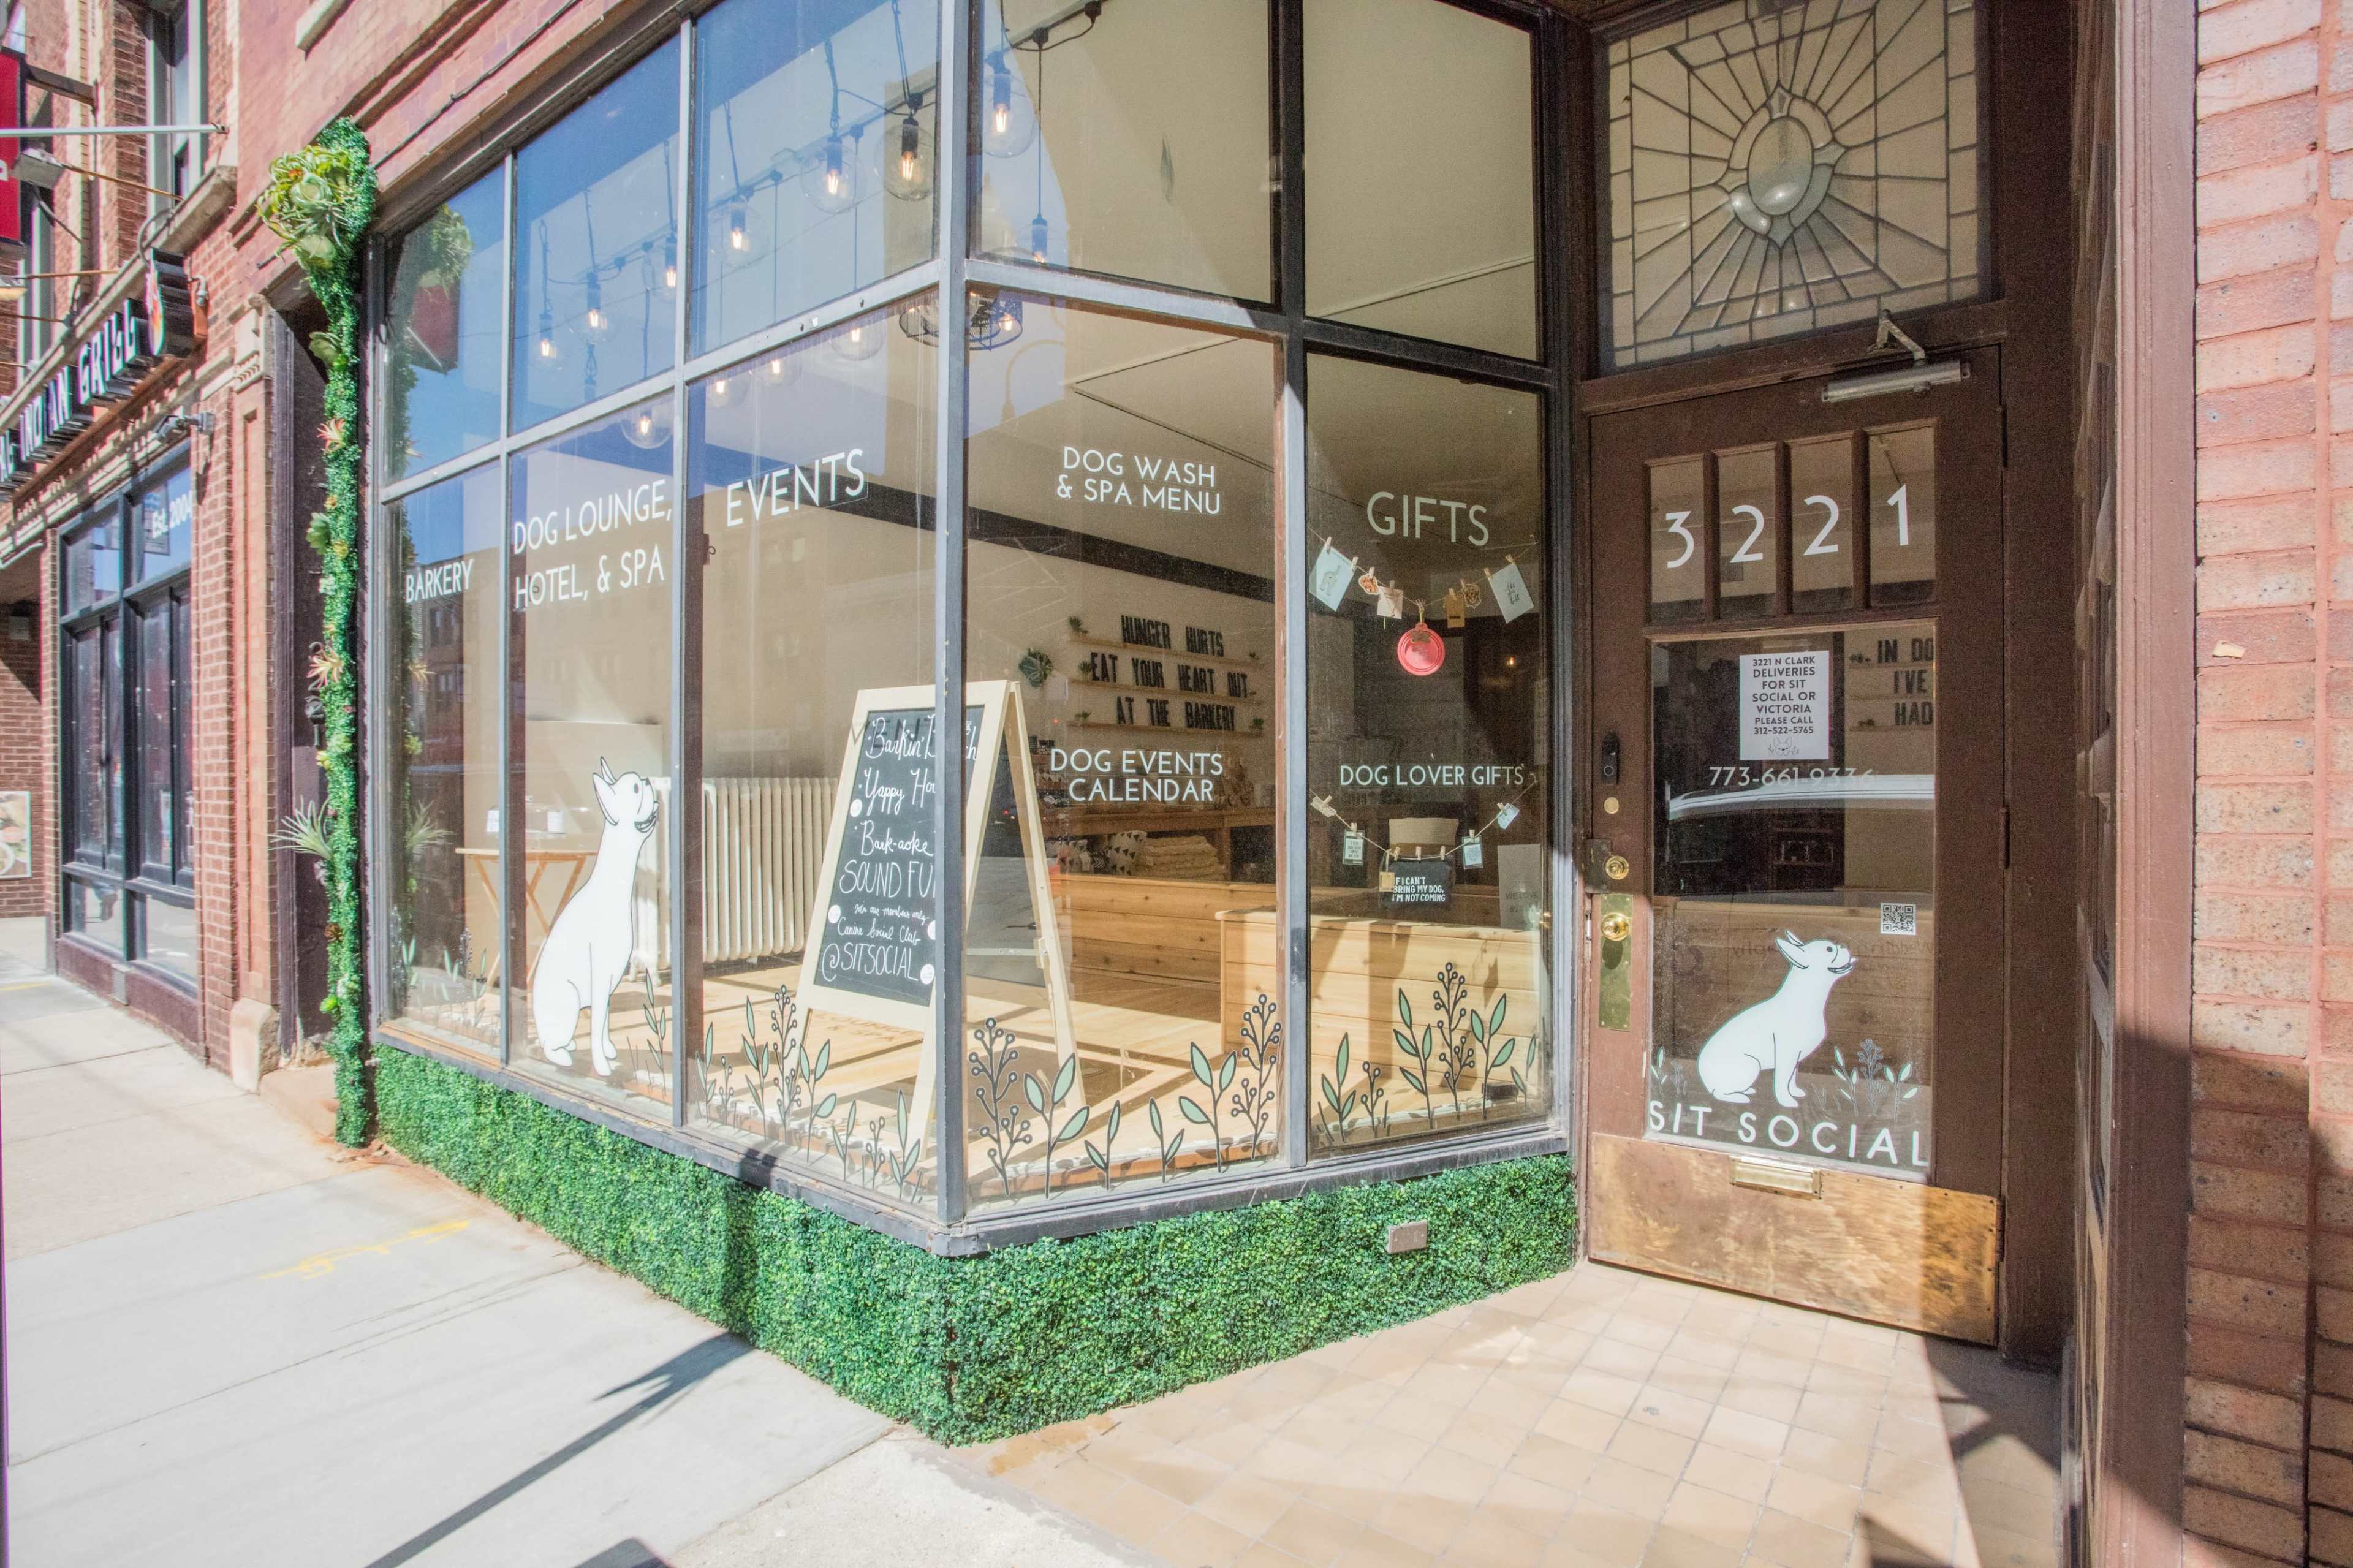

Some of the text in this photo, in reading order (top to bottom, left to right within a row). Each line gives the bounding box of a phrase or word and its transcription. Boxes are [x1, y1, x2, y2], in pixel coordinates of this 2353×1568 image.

[20, 366, 71, 461] INDIAN
[78, 300, 137, 405] GRILL
[1063, 446, 1215, 487] DOG WASH
[726, 448, 865, 527] EVENTS
[1056, 474, 1221, 515] & SPA MENU
[514, 479, 673, 555] DOG LOUNGE,
[1366, 491, 1490, 547] GIFTS
[404, 558, 475, 604] BARKERY
[515, 543, 665, 609] HOTEL, & SPA
[1121, 615, 1224, 657] HUNGER HURTS
[1877, 639, 1898, 663] IN
[1091, 652, 1248, 699] EAT YOUR HEART OUT
[1752, 658, 1771, 667] 3221
[1784, 656, 1815, 665] CLARK
[1753, 667, 1815, 678] DELIVERIES
[1752, 692, 1816, 702] SOCIAL OR
[1762, 680, 1806, 689] FOR SIT
[1893, 668, 1927, 694] I'VE
[1116, 696, 1235, 731] AT THE BARKERY
[1756, 705, 1811, 714] VICTORIA
[1895, 701, 1934, 726] HAD
[1754, 726, 1814, 735] 312-522-5765
[1051, 748, 1223, 776] DOG EVENTS
[1339, 765, 1524, 786] DOG LOVER GIFTS
[864, 767, 904, 816] Yappy
[1069, 778, 1214, 801] CALENDAR
[860, 820, 934, 856] Bark-aoke
[839, 859, 902, 898] SOUND
[882, 905, 910, 918] members
[838, 917, 921, 945] Canine Social Club
[822, 942, 919, 982] @SITSOCIAL
[1649, 1100, 1930, 1166] SIT SOCIAL
